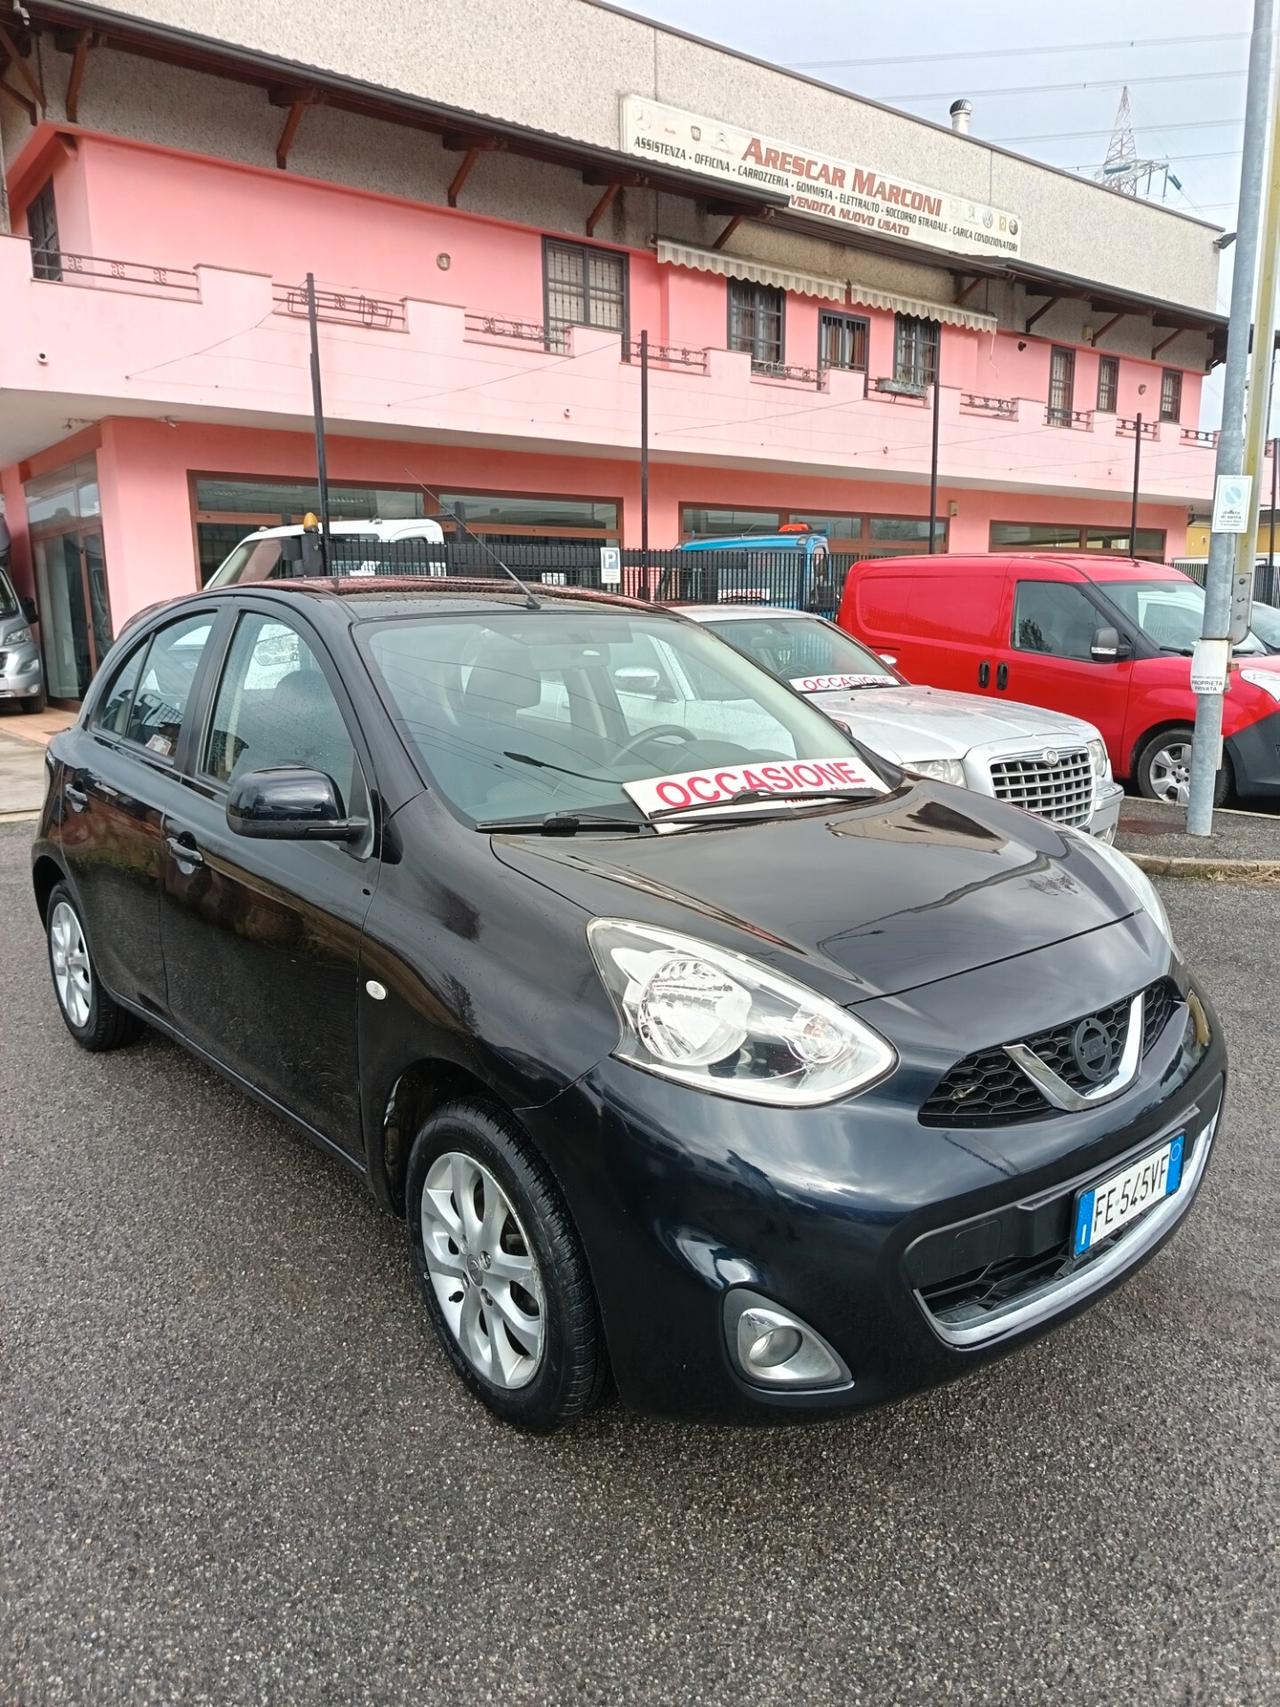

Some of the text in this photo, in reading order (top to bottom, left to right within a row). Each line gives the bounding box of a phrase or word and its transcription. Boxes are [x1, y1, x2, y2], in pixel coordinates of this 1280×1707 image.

[634, 135, 1018, 252] ASSISTENZA OFFICINA CARROZZERIA GOMMISTA ELETTRAUTO SOCCORSO STRADALE CARICA CONDIZIONATORI
[790, 194, 910, 236] VENDITA NUOVO USATO
[604, 551, 617, 569] P
[656, 762, 865, 809] OCCASIONE
